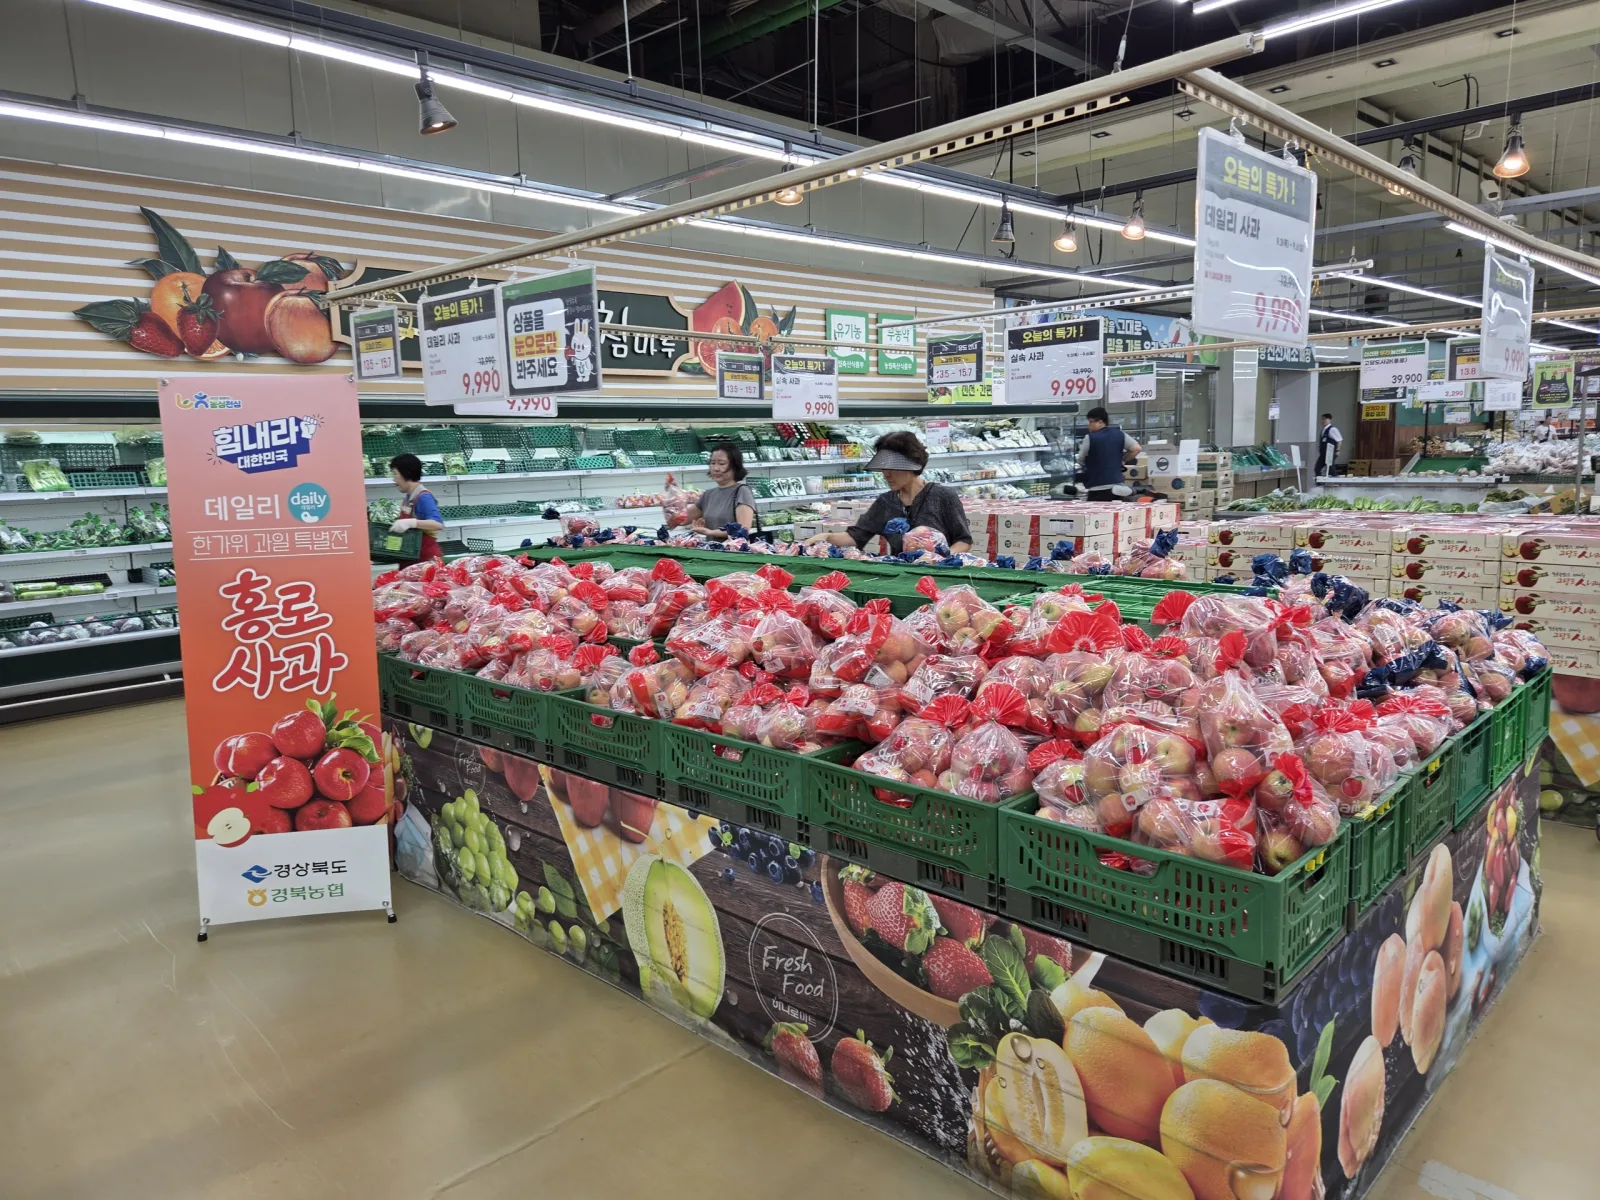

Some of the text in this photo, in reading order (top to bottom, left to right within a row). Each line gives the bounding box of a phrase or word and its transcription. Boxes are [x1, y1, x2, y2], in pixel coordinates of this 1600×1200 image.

[1223, 156, 1295, 205] 오늘의 특가 !
[1205, 205, 1260, 240] 데일리 사과
[433, 296, 483, 321] 오늘의 특가 !
[1255, 291, 1302, 334] 9,990
[513, 308, 545, 334] 상품을
[427, 332, 460, 348] 데일리 사과
[835, 323, 862, 340] 유기농
[887, 327, 910, 342] 무농약
[1023, 325, 1084, 344] 오늘의 특가 !
[514, 331, 557, 358] 눈으로만
[784, 360, 806, 370] 오늘의
[807, 361, 821, 371] 특가
[838, 361, 864, 369] 림축산식품부
[884, 362, 912, 370] 농림축산식품부
[1010, 351, 1044, 364] 실속 사과
[516, 356, 558, 380] 봐주세요
[959, 368, 973, 377] 15.7
[1460, 367, 1476, 376] 13.8
[463, 369, 500, 396] 9,990
[789, 377, 801, 385] 사과
[1051, 376, 1096, 397] 9,990
[1392, 373, 1422, 384] 39,900
[727, 384, 738, 393] 13.5
[745, 386, 756, 394] 15.7
[1131, 389, 1153, 398] 26,990
[805, 401, 834, 415] 9,990
[213, 416, 300, 456] 힘내라
[237, 450, 288, 469] 대한민국
[204, 494, 280, 521] 데일리
[291, 492, 327, 506] daily
[192, 530, 348, 556] 한가위 과일 특별전
[219, 567, 333, 643] 홍로
[212, 632, 349, 700] 사과
[1121, 769, 1161, 786] daily
[957, 779, 988, 800] daily
[274, 859, 348, 879] 경상북도
[271, 882, 344, 903] 경북농협
[762, 945, 813, 974] Fresh
[783, 974, 825, 998] Food
[772, 997, 817, 1027] 하나로마트
